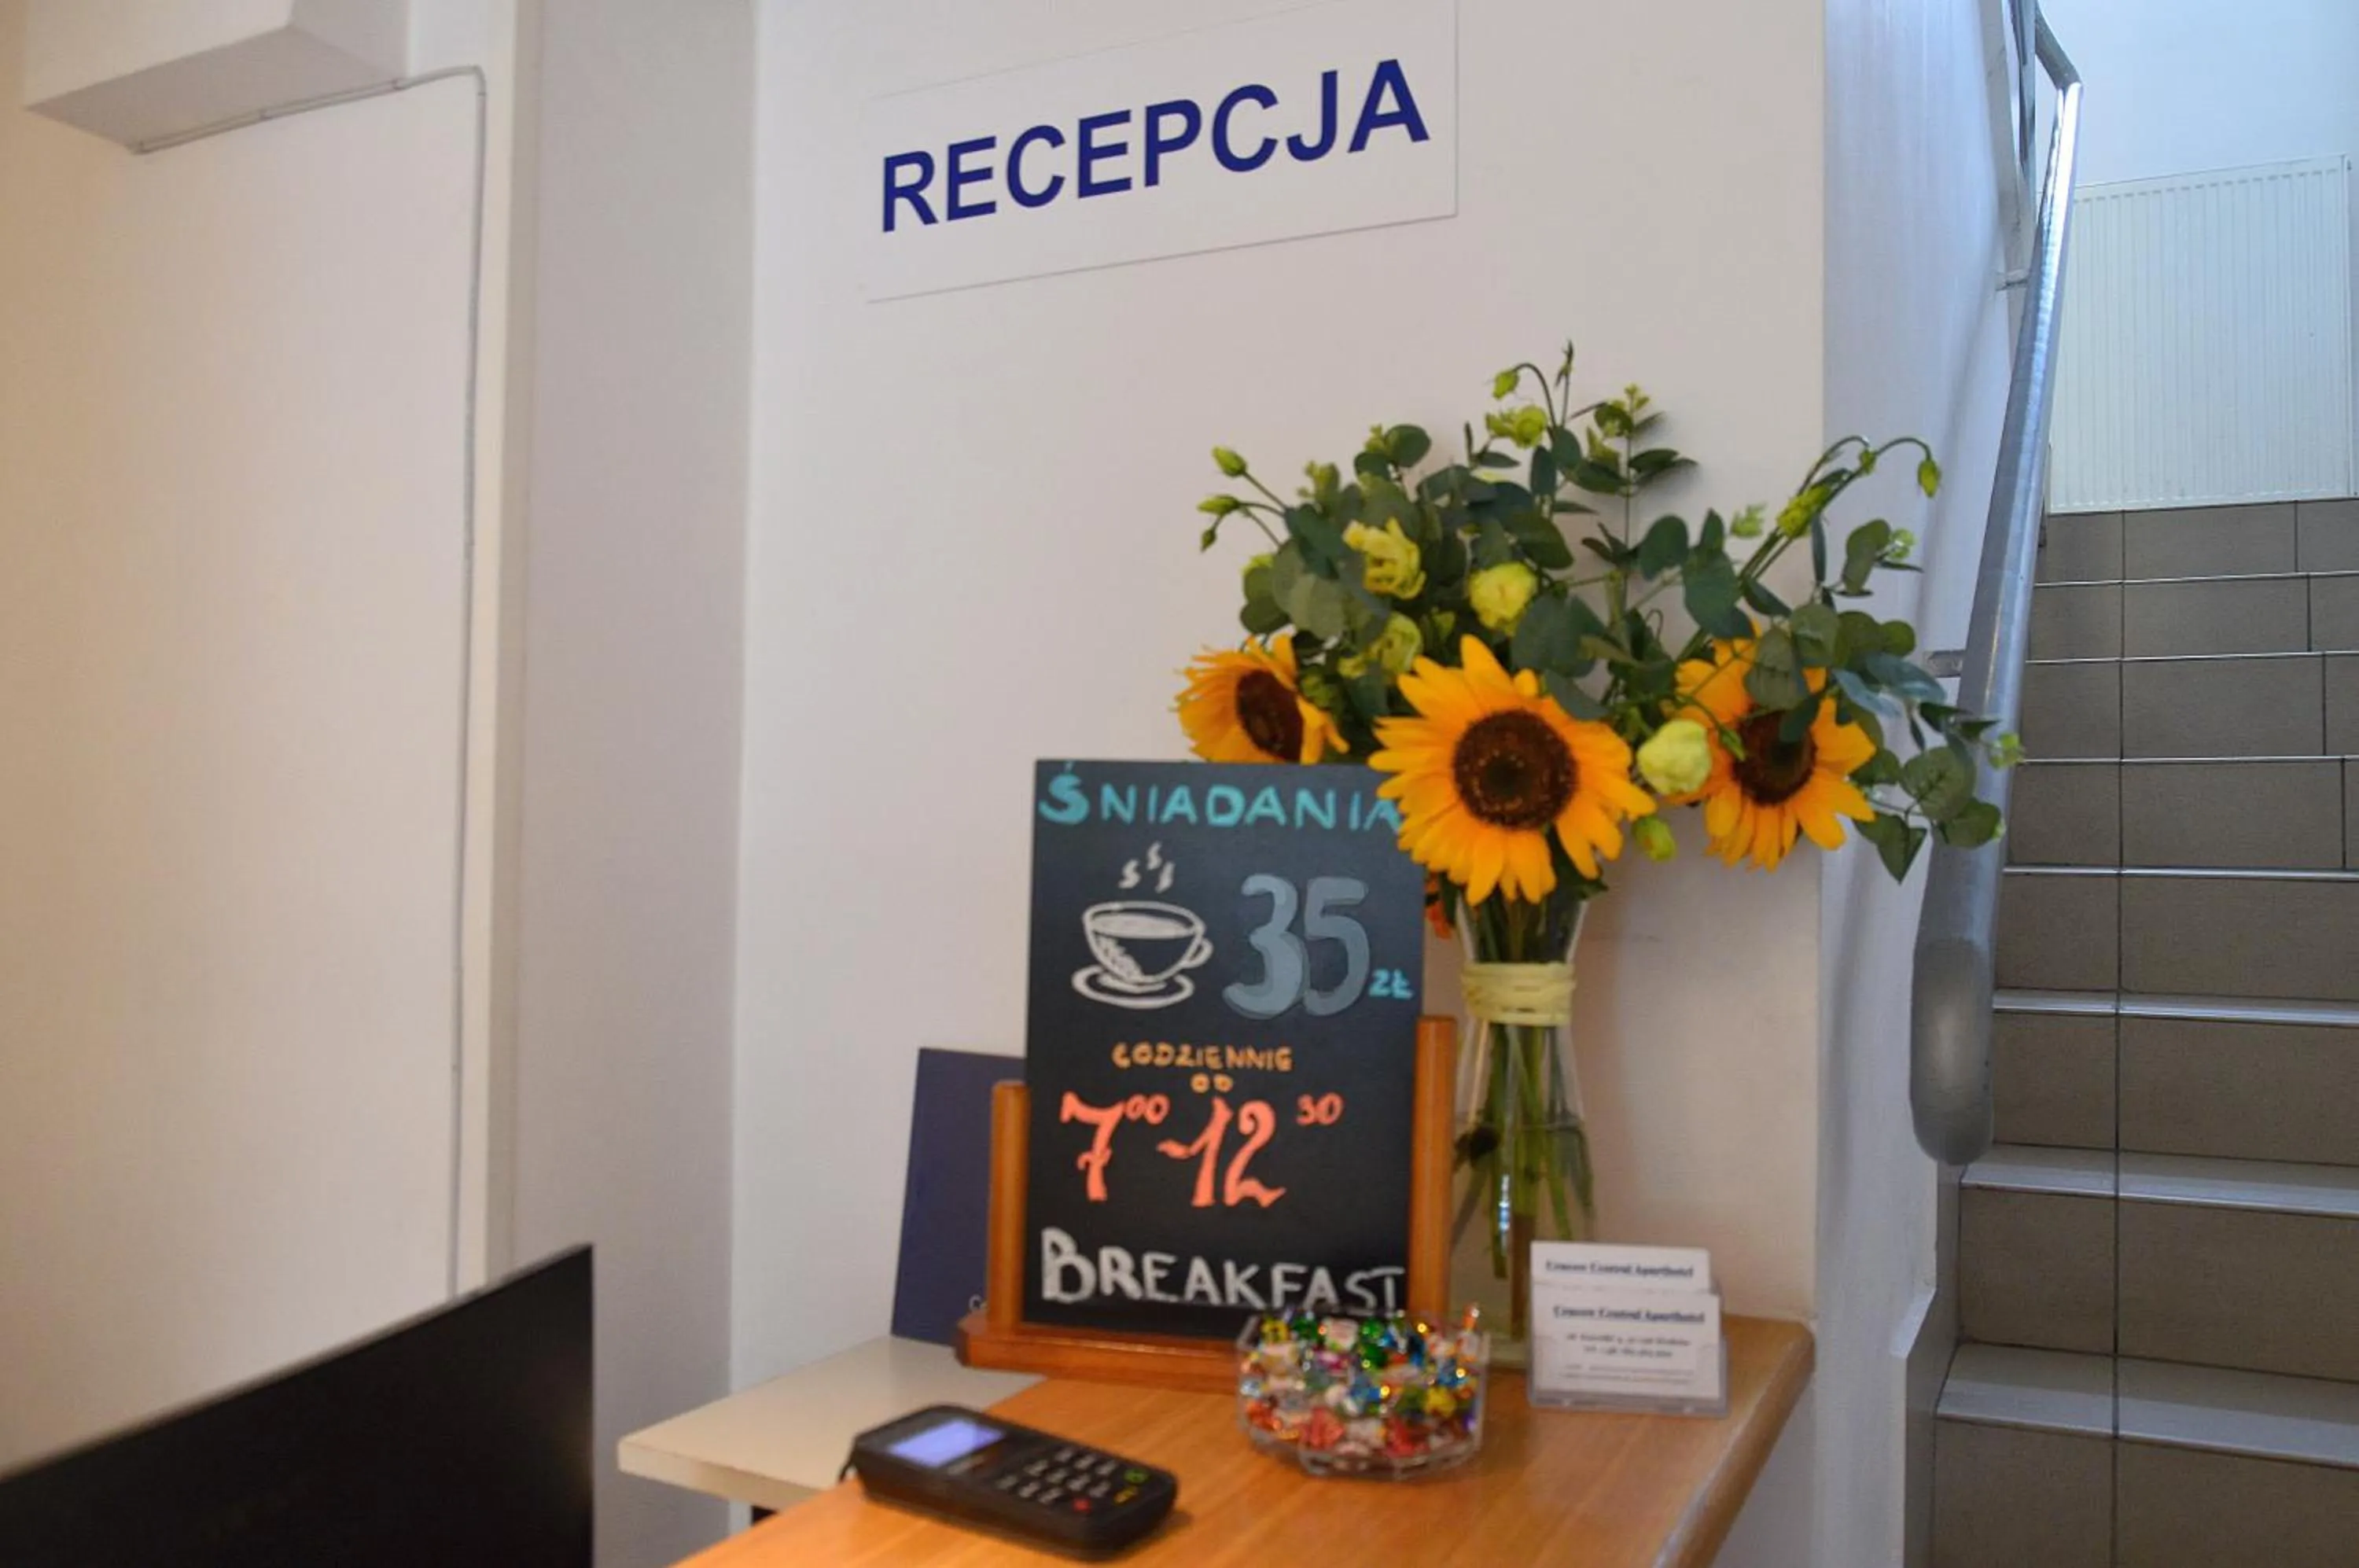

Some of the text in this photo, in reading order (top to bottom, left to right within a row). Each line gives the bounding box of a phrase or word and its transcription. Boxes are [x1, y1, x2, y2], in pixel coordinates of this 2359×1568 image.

[882, 59, 1430, 233] RECEPCJA
[1038, 761, 1403, 833] ŚNIADANIA
[1222, 874, 1370, 1021] 35
[1191, 1073, 1234, 1093] OD
[1040, 1226, 1406, 1320] BREAKFAST
